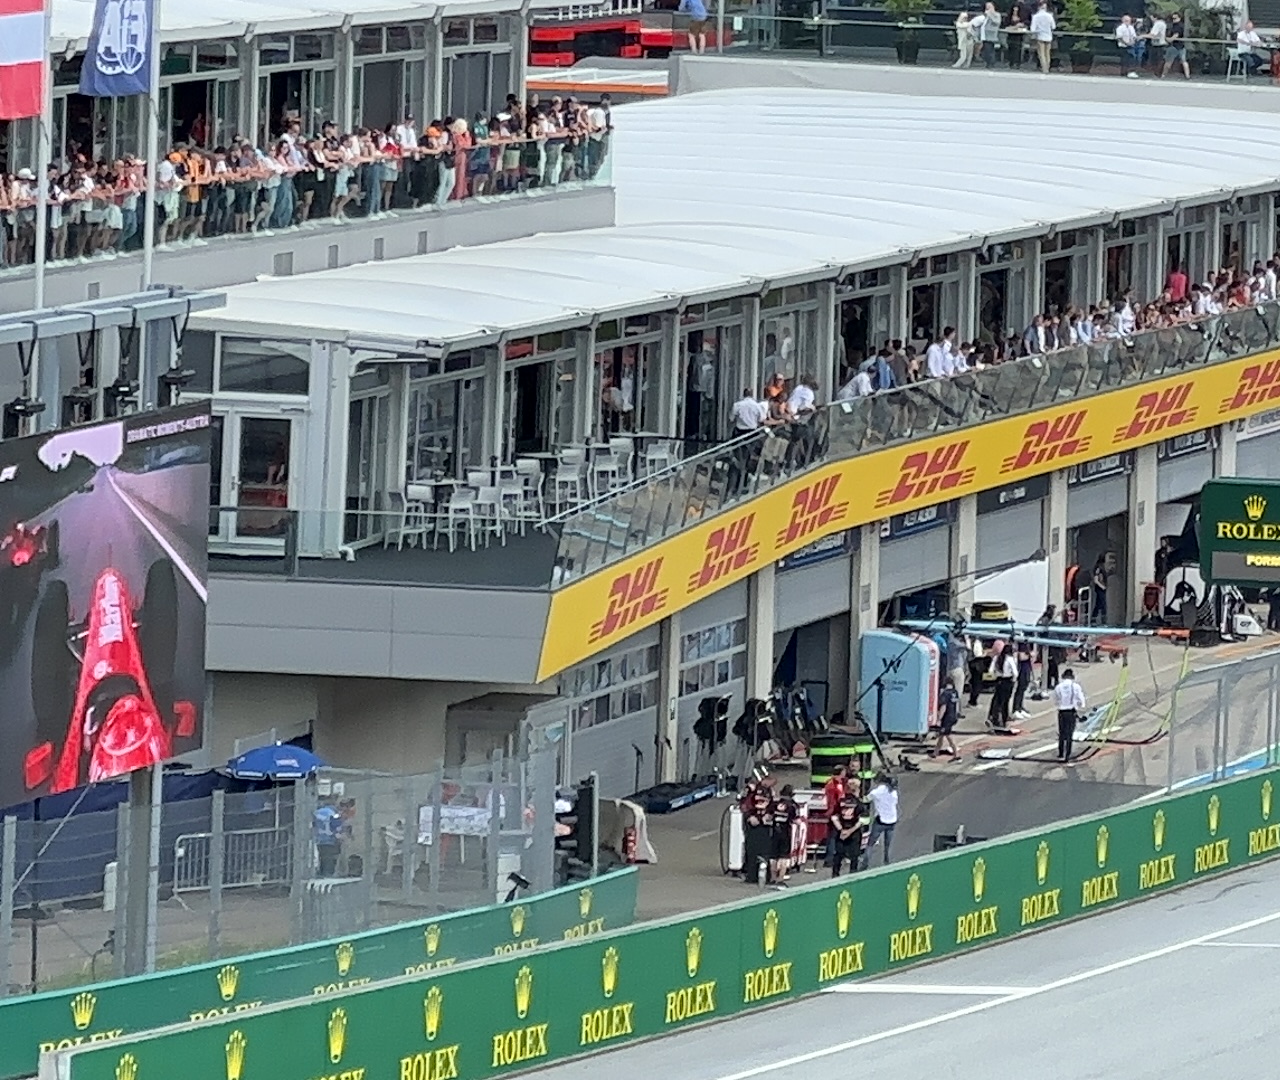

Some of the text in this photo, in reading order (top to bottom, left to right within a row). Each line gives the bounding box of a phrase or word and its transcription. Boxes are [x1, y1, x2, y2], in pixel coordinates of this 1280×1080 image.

[1114, 383, 1198, 443] DHL
[1000, 410, 1091, 473] DHL
[876, 440, 976, 508] DHL
[778, 473, 849, 545] DHL
[690, 513, 758, 589] DHL
[591, 557, 668, 642] DHL
[1139, 854, 1176, 889] ROLEX
[1194, 839, 1229, 873] ROLEX
[1021, 888, 1060, 925] ROLEX
[1082, 871, 1119, 907] ROLEX
[890, 924, 933, 961] ROLEX
[956, 906, 998, 943] ROLEX
[744, 961, 792, 1002] ROLEX
[819, 943, 864, 981] ROLEX
[665, 981, 717, 1023] ROLEX
[580, 1002, 633, 1044] ROLEX
[400, 1044, 459, 1080] ROLEX
[493, 1023, 548, 1066] ROLEX
